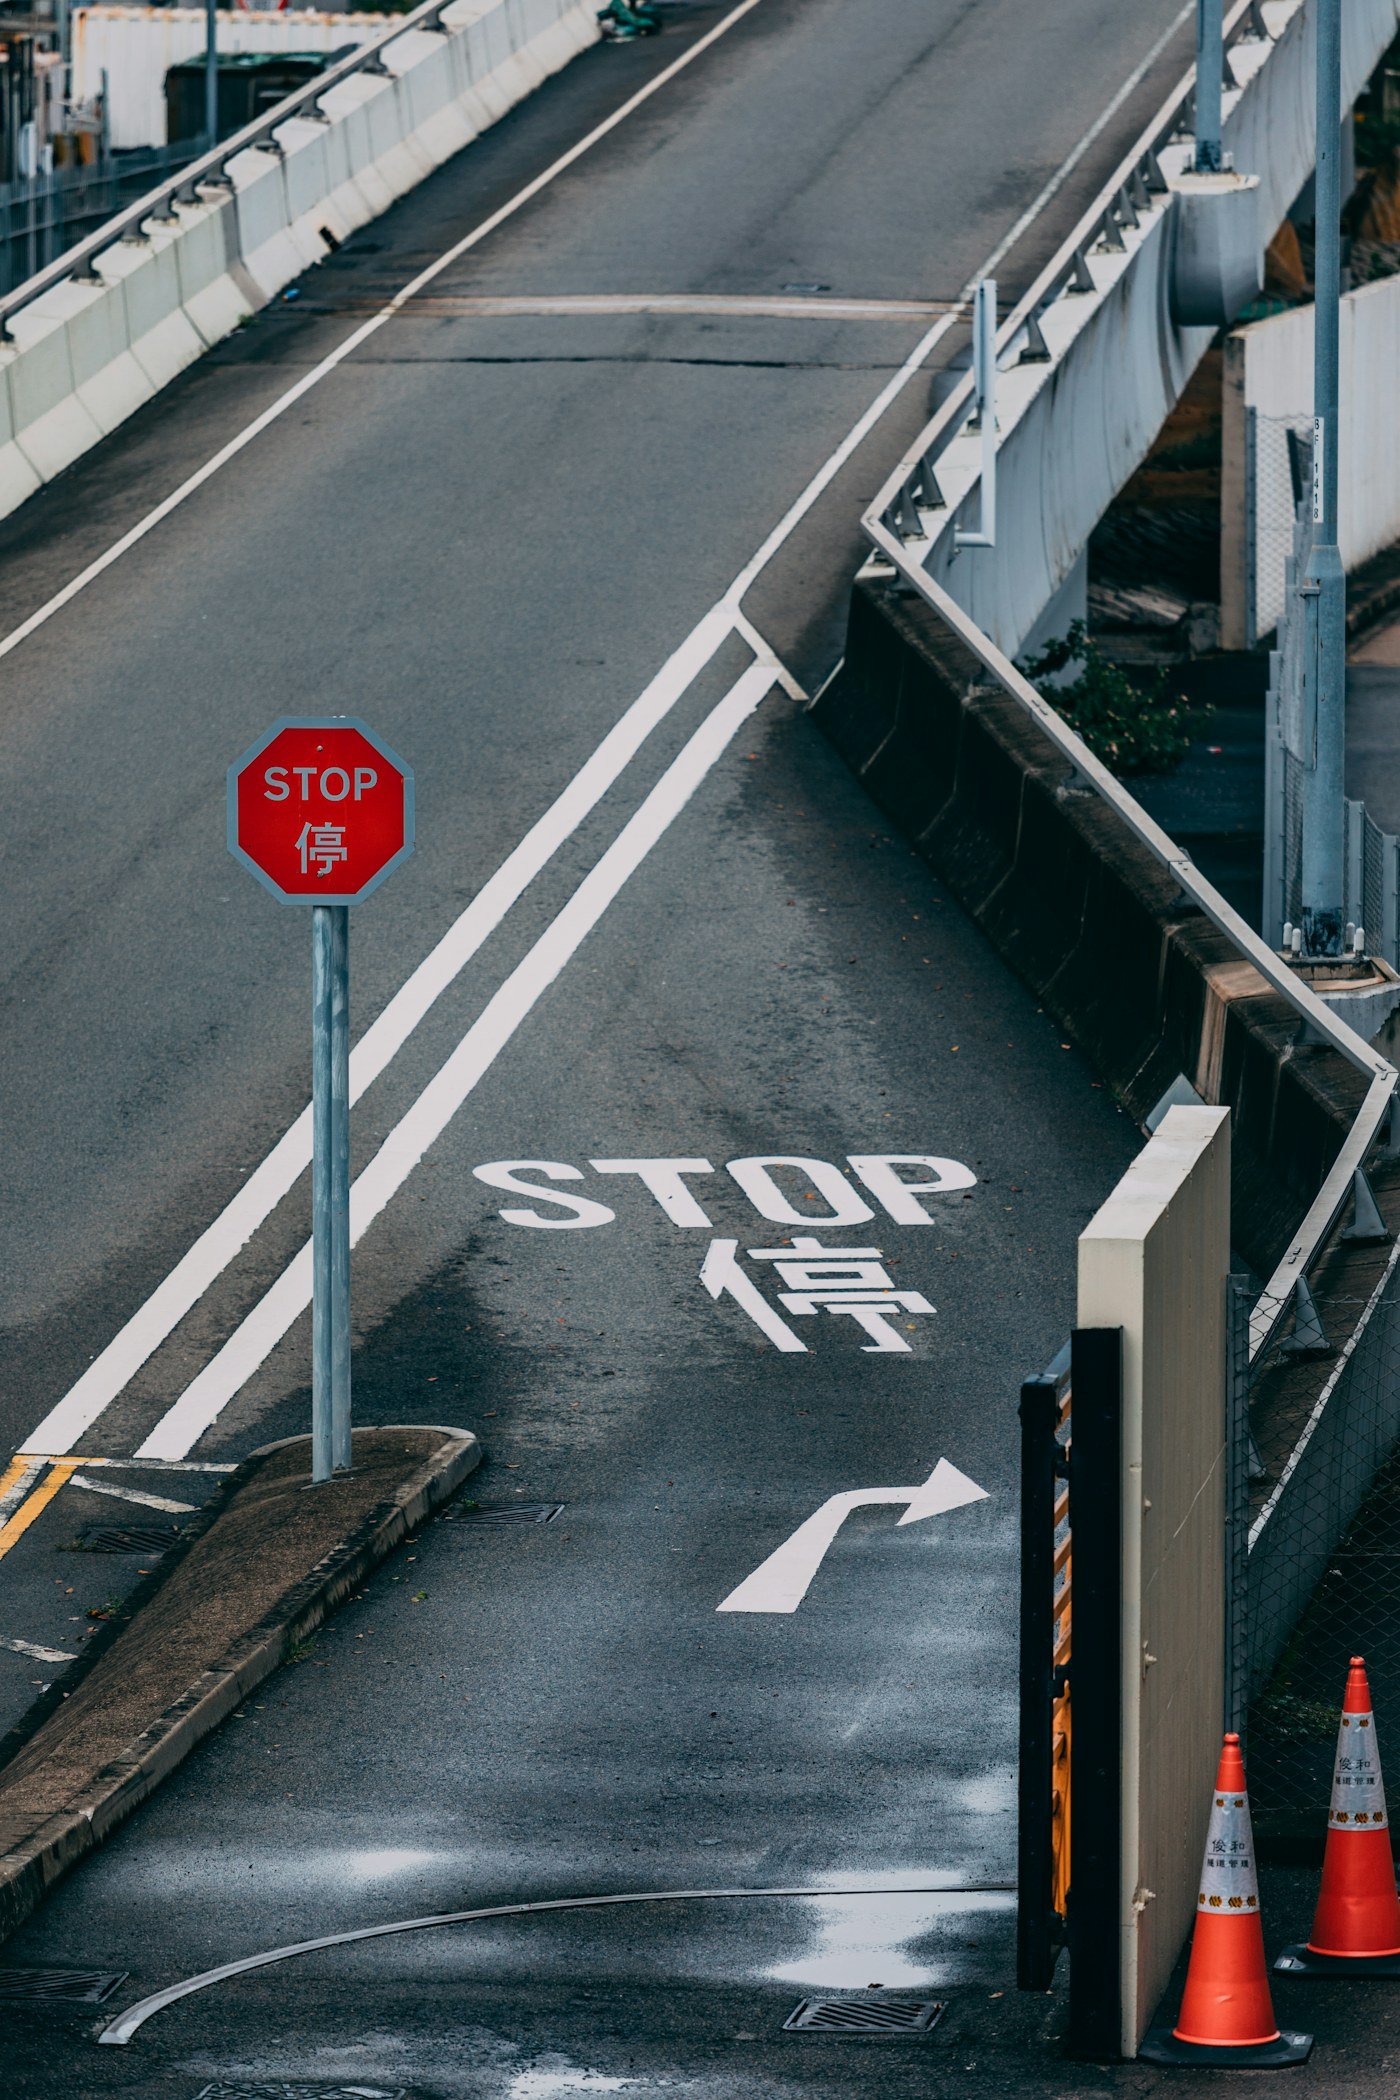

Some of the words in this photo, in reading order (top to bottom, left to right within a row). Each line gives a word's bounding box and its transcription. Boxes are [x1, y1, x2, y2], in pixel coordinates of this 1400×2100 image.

[264, 766, 378, 802] STOP
[295, 821, 348, 875] 停
[472, 1155, 978, 1230] STOP
[699, 1237, 938, 1353] 停
[1339, 1756, 1371, 1771] 俊和
[1212, 1839, 1246, 1853] 俊和
